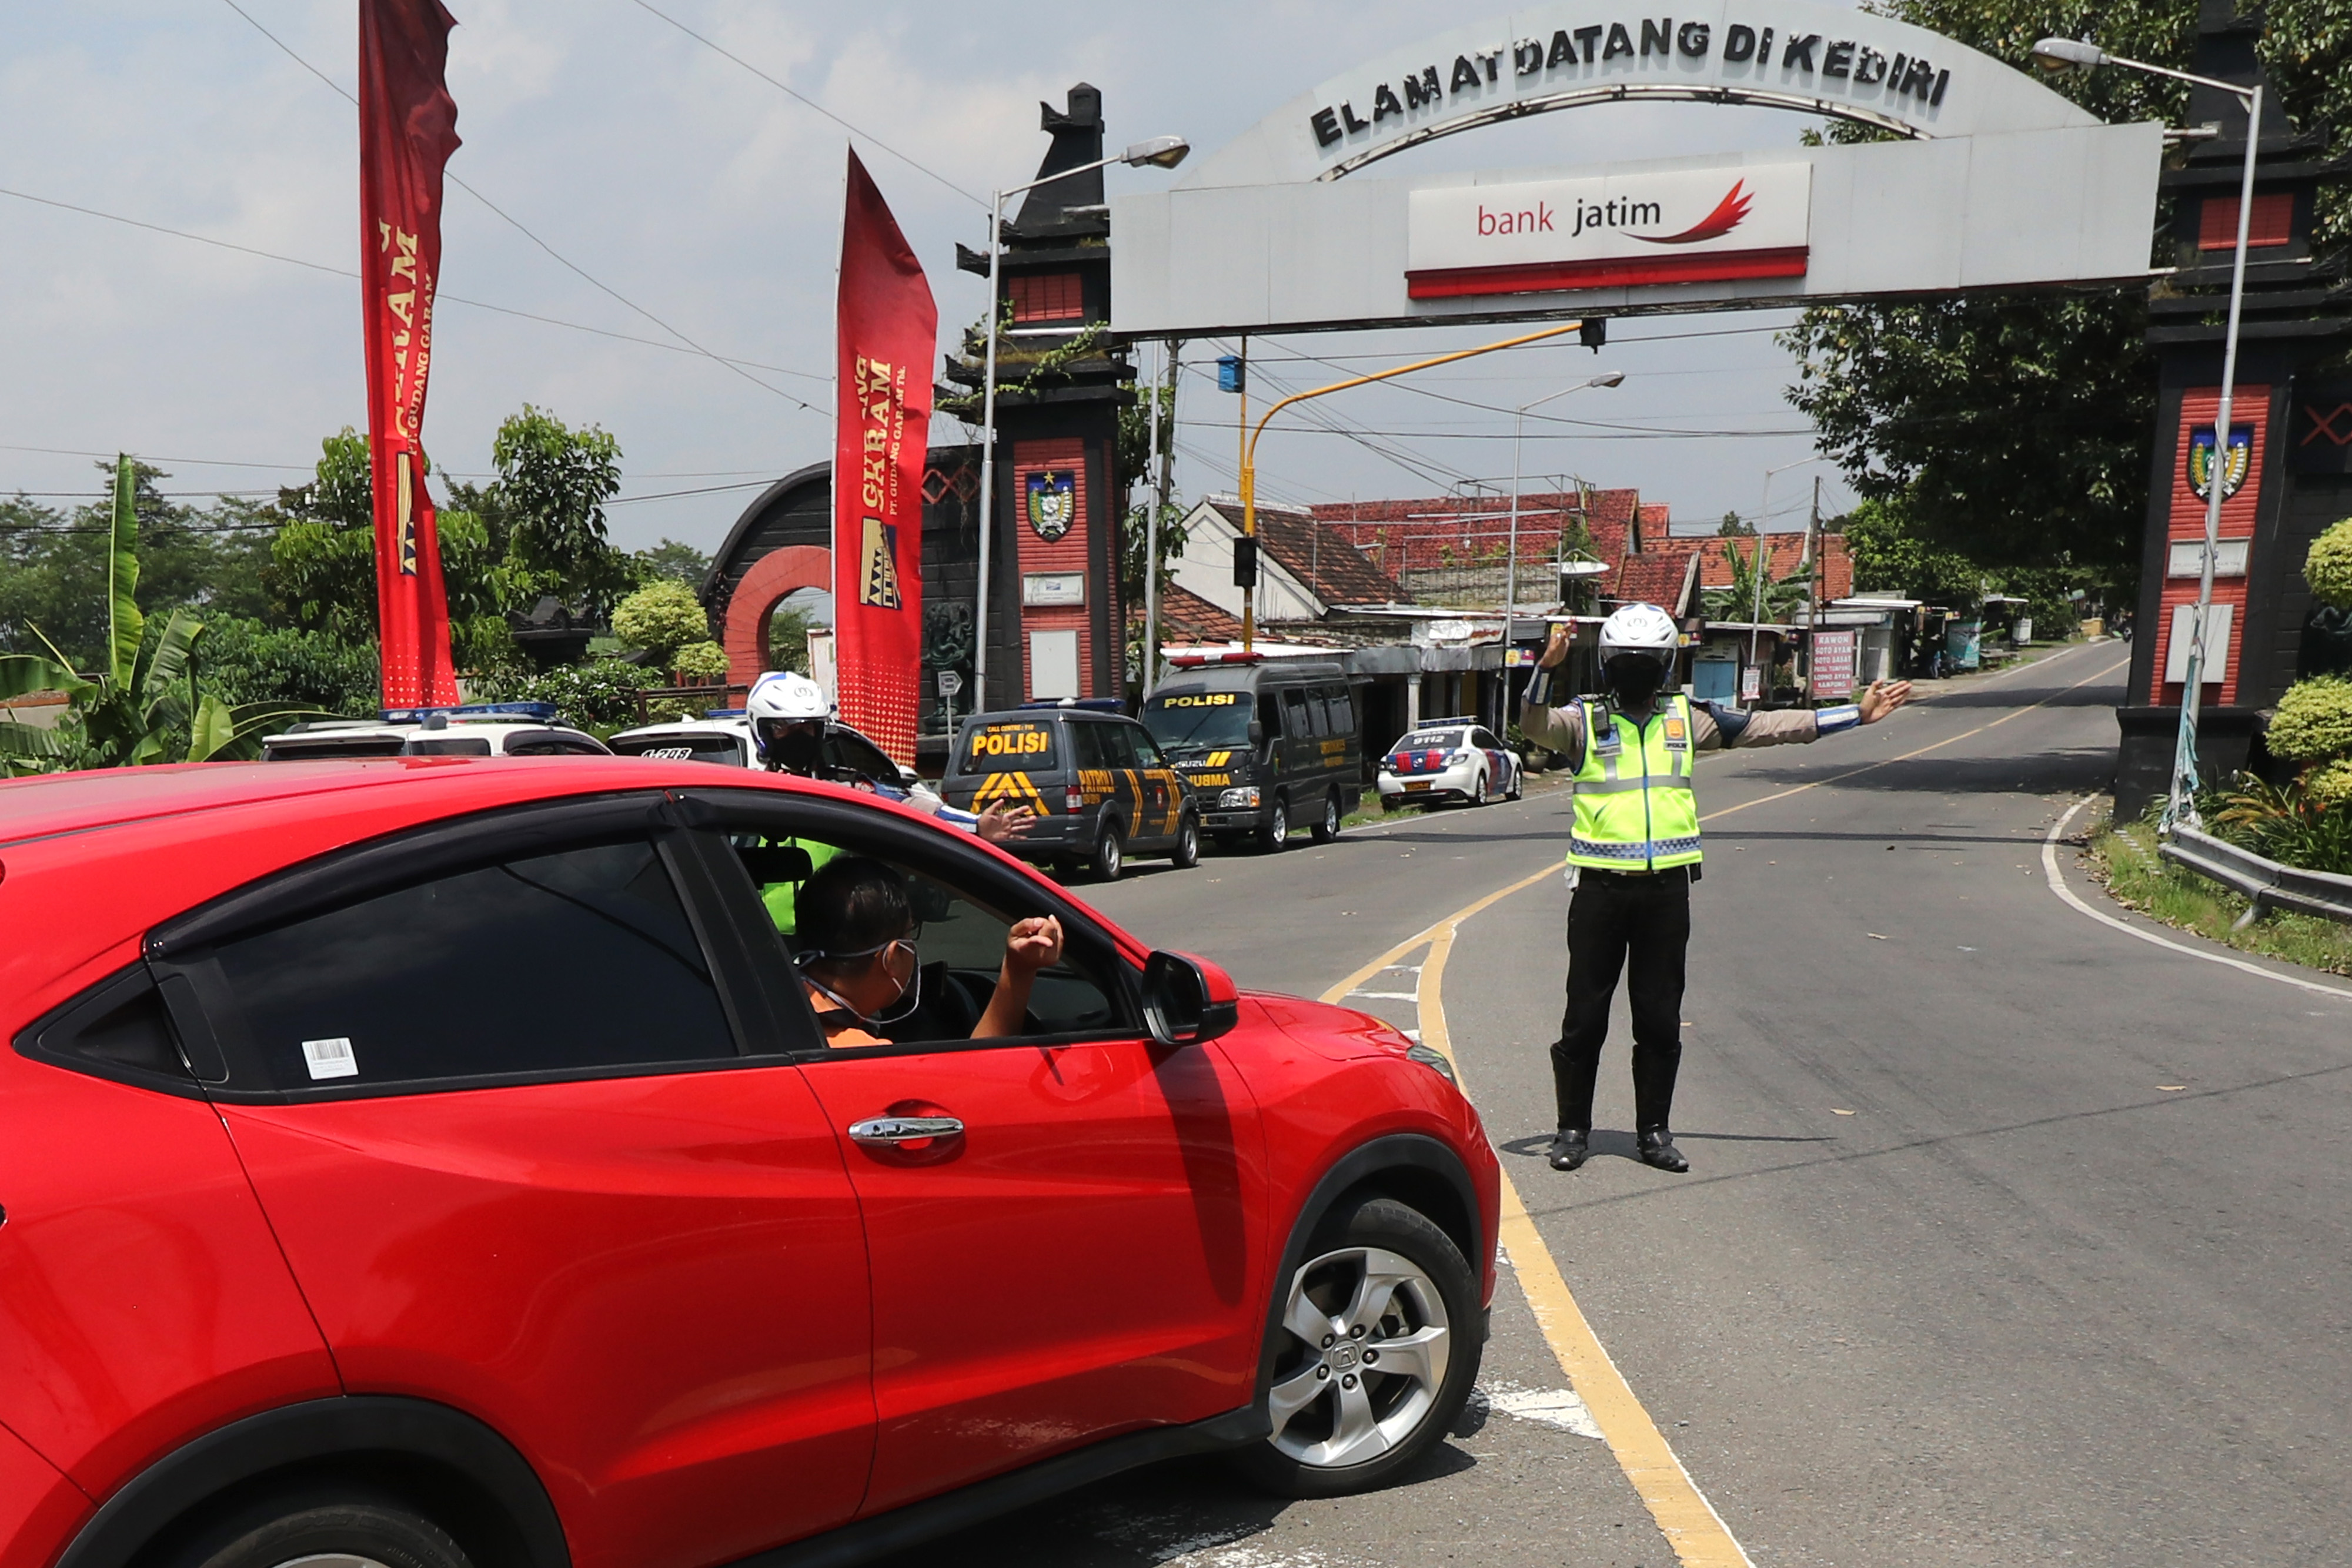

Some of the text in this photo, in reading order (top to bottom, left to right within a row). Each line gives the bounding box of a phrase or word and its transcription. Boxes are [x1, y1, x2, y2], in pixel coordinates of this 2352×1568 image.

[1310, 17, 1950, 147] ELAMAT DATANG DI KEDIRI
[1478, 198, 1662, 237] bank jatim
[408, 352, 429, 429] GUDANG
[889, 365, 906, 516] PT. GUDANG GARAM Tbk.
[1164, 694, 1235, 708] POLISI
[972, 731, 1048, 757] POLISI
[1412, 735, 1445, 745] 9112
